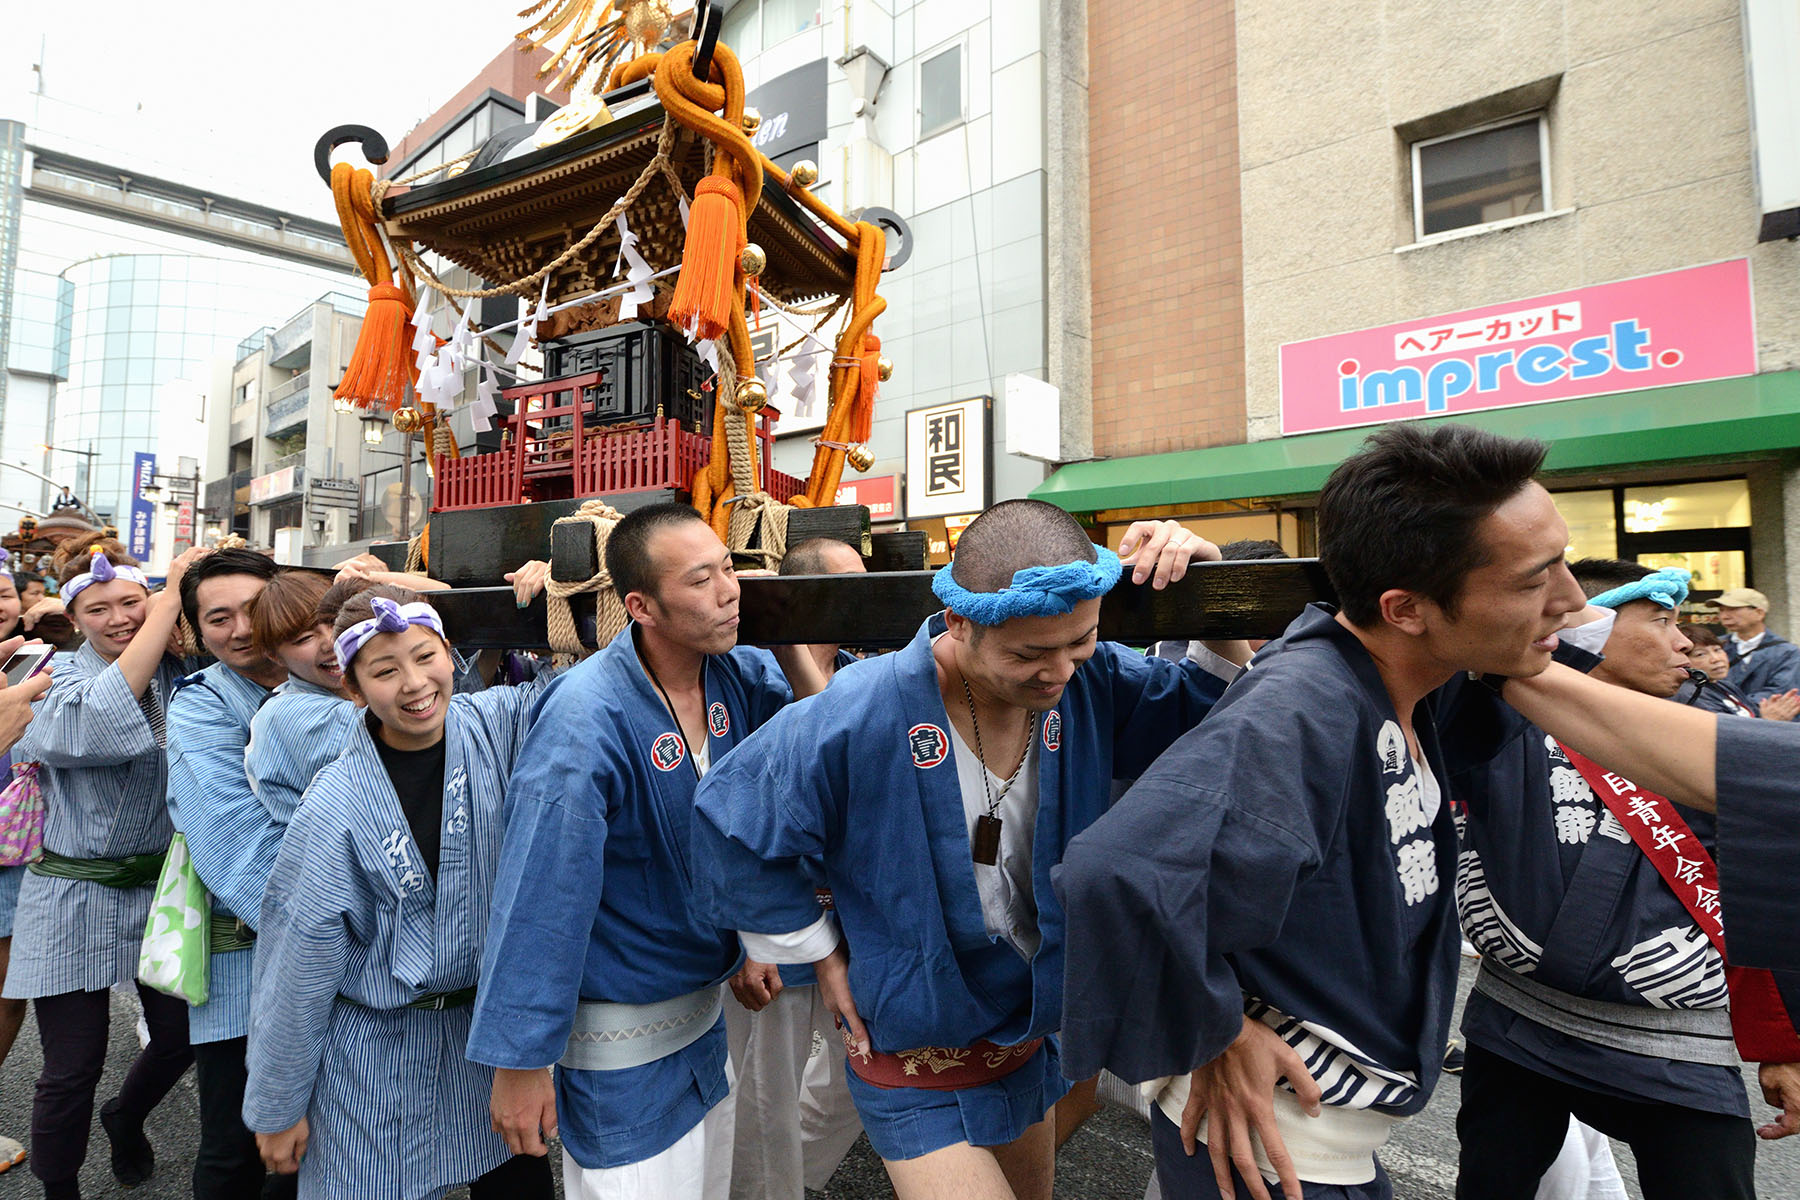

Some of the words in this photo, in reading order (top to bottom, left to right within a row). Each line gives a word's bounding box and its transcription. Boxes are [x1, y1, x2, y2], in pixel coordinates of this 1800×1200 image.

[752, 112, 788, 147] en
[1400, 309, 1575, 351] ヘアーカット
[928, 413, 960, 492] 和民
